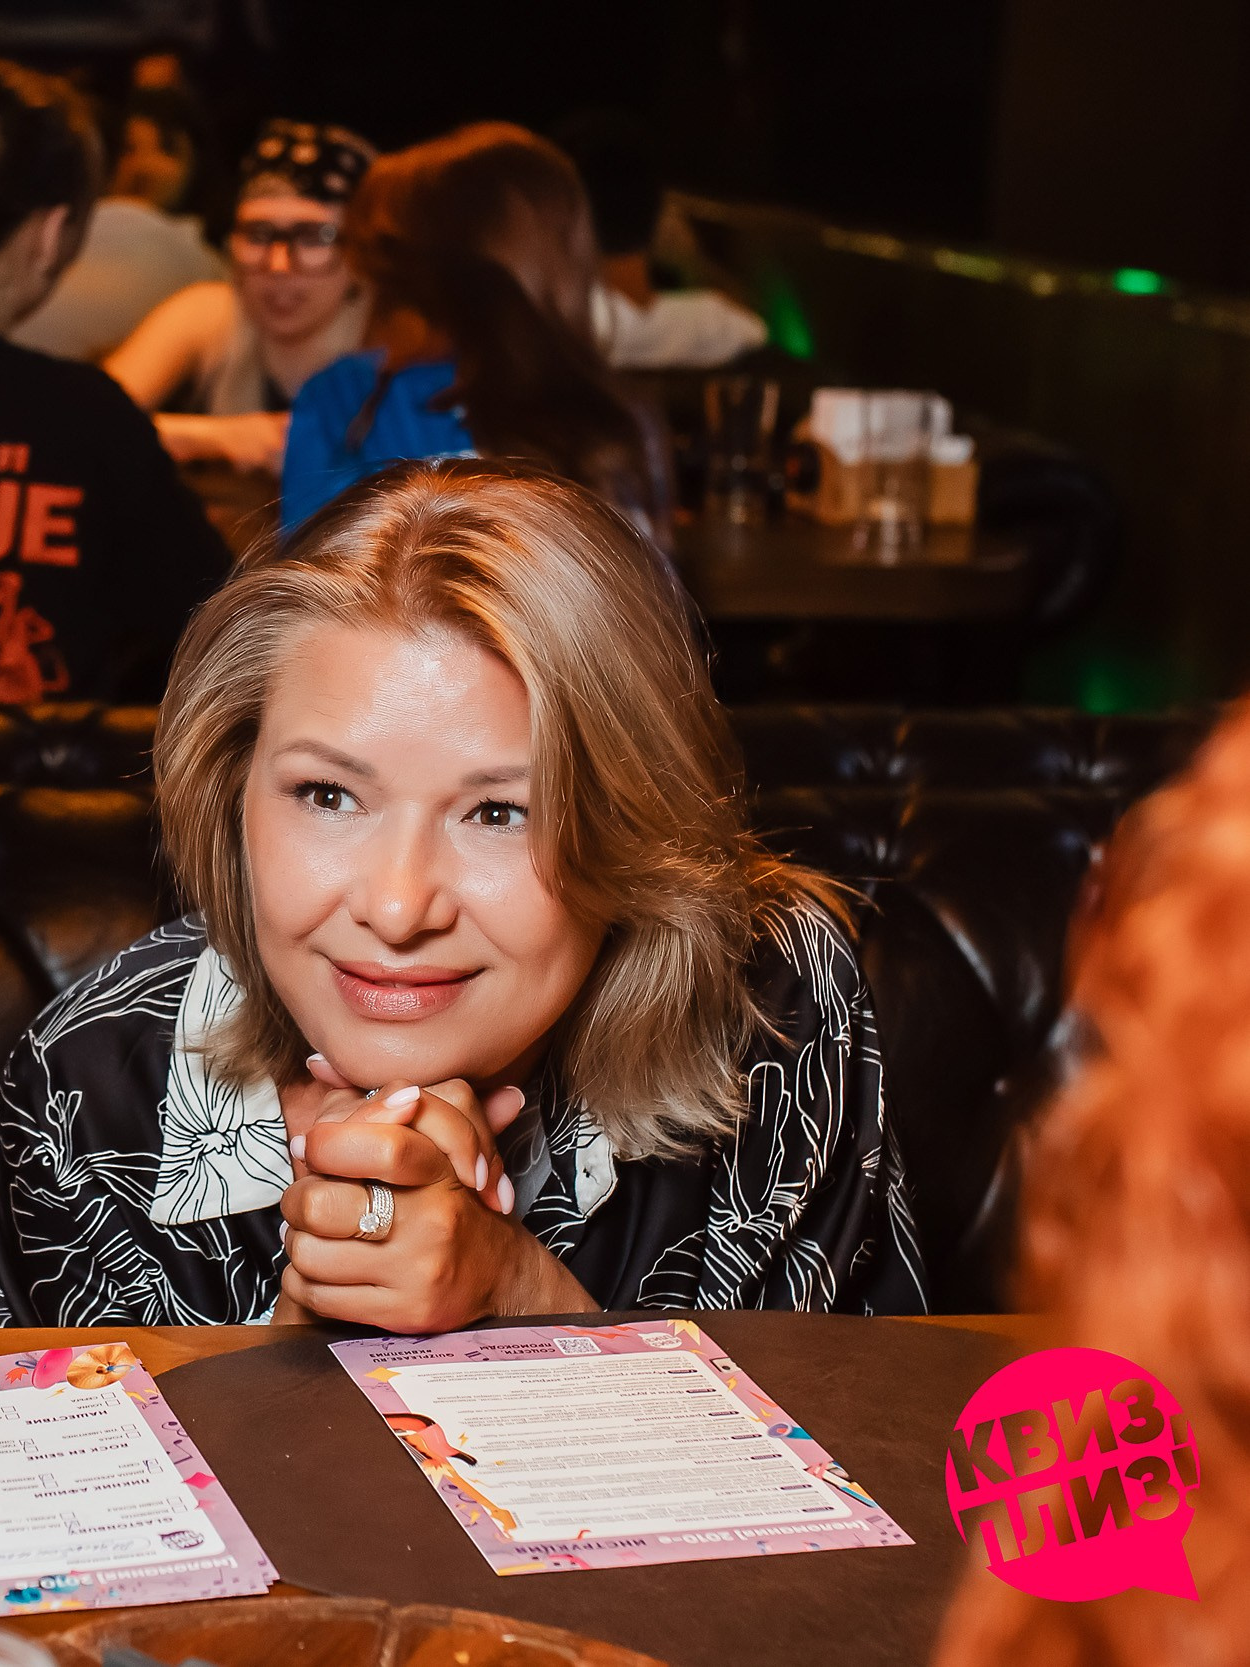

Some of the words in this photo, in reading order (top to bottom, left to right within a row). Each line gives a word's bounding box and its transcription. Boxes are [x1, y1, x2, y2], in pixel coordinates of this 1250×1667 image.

[480, 1342, 552, 1351] ПРОМОКОДЫ
[503, 1347, 556, 1355] СОЦСЕТИ,
[369, 1348, 433, 1357] #КВИЗПЛИЗ
[372, 1352, 455, 1362] QUIZPLEASE.RU
[24, 1410, 108, 1425] НАШЕСТВИЕ
[89, 1443, 128, 1452] ROCK
[26, 1452, 64, 1460] SEINE
[692, 1456, 749, 1464] Кроссворд
[92, 1478, 150, 1490] ПИКНИК
[32, 1487, 89, 1498] АФИШИ
[66, 1517, 174, 1534] GLASTONBURY
[730, 1519, 871, 1540] [меломания]
[654, 1530, 735, 1545] 2010-е
[512, 1538, 648, 1554] ИНСТРУКЦИЯ
